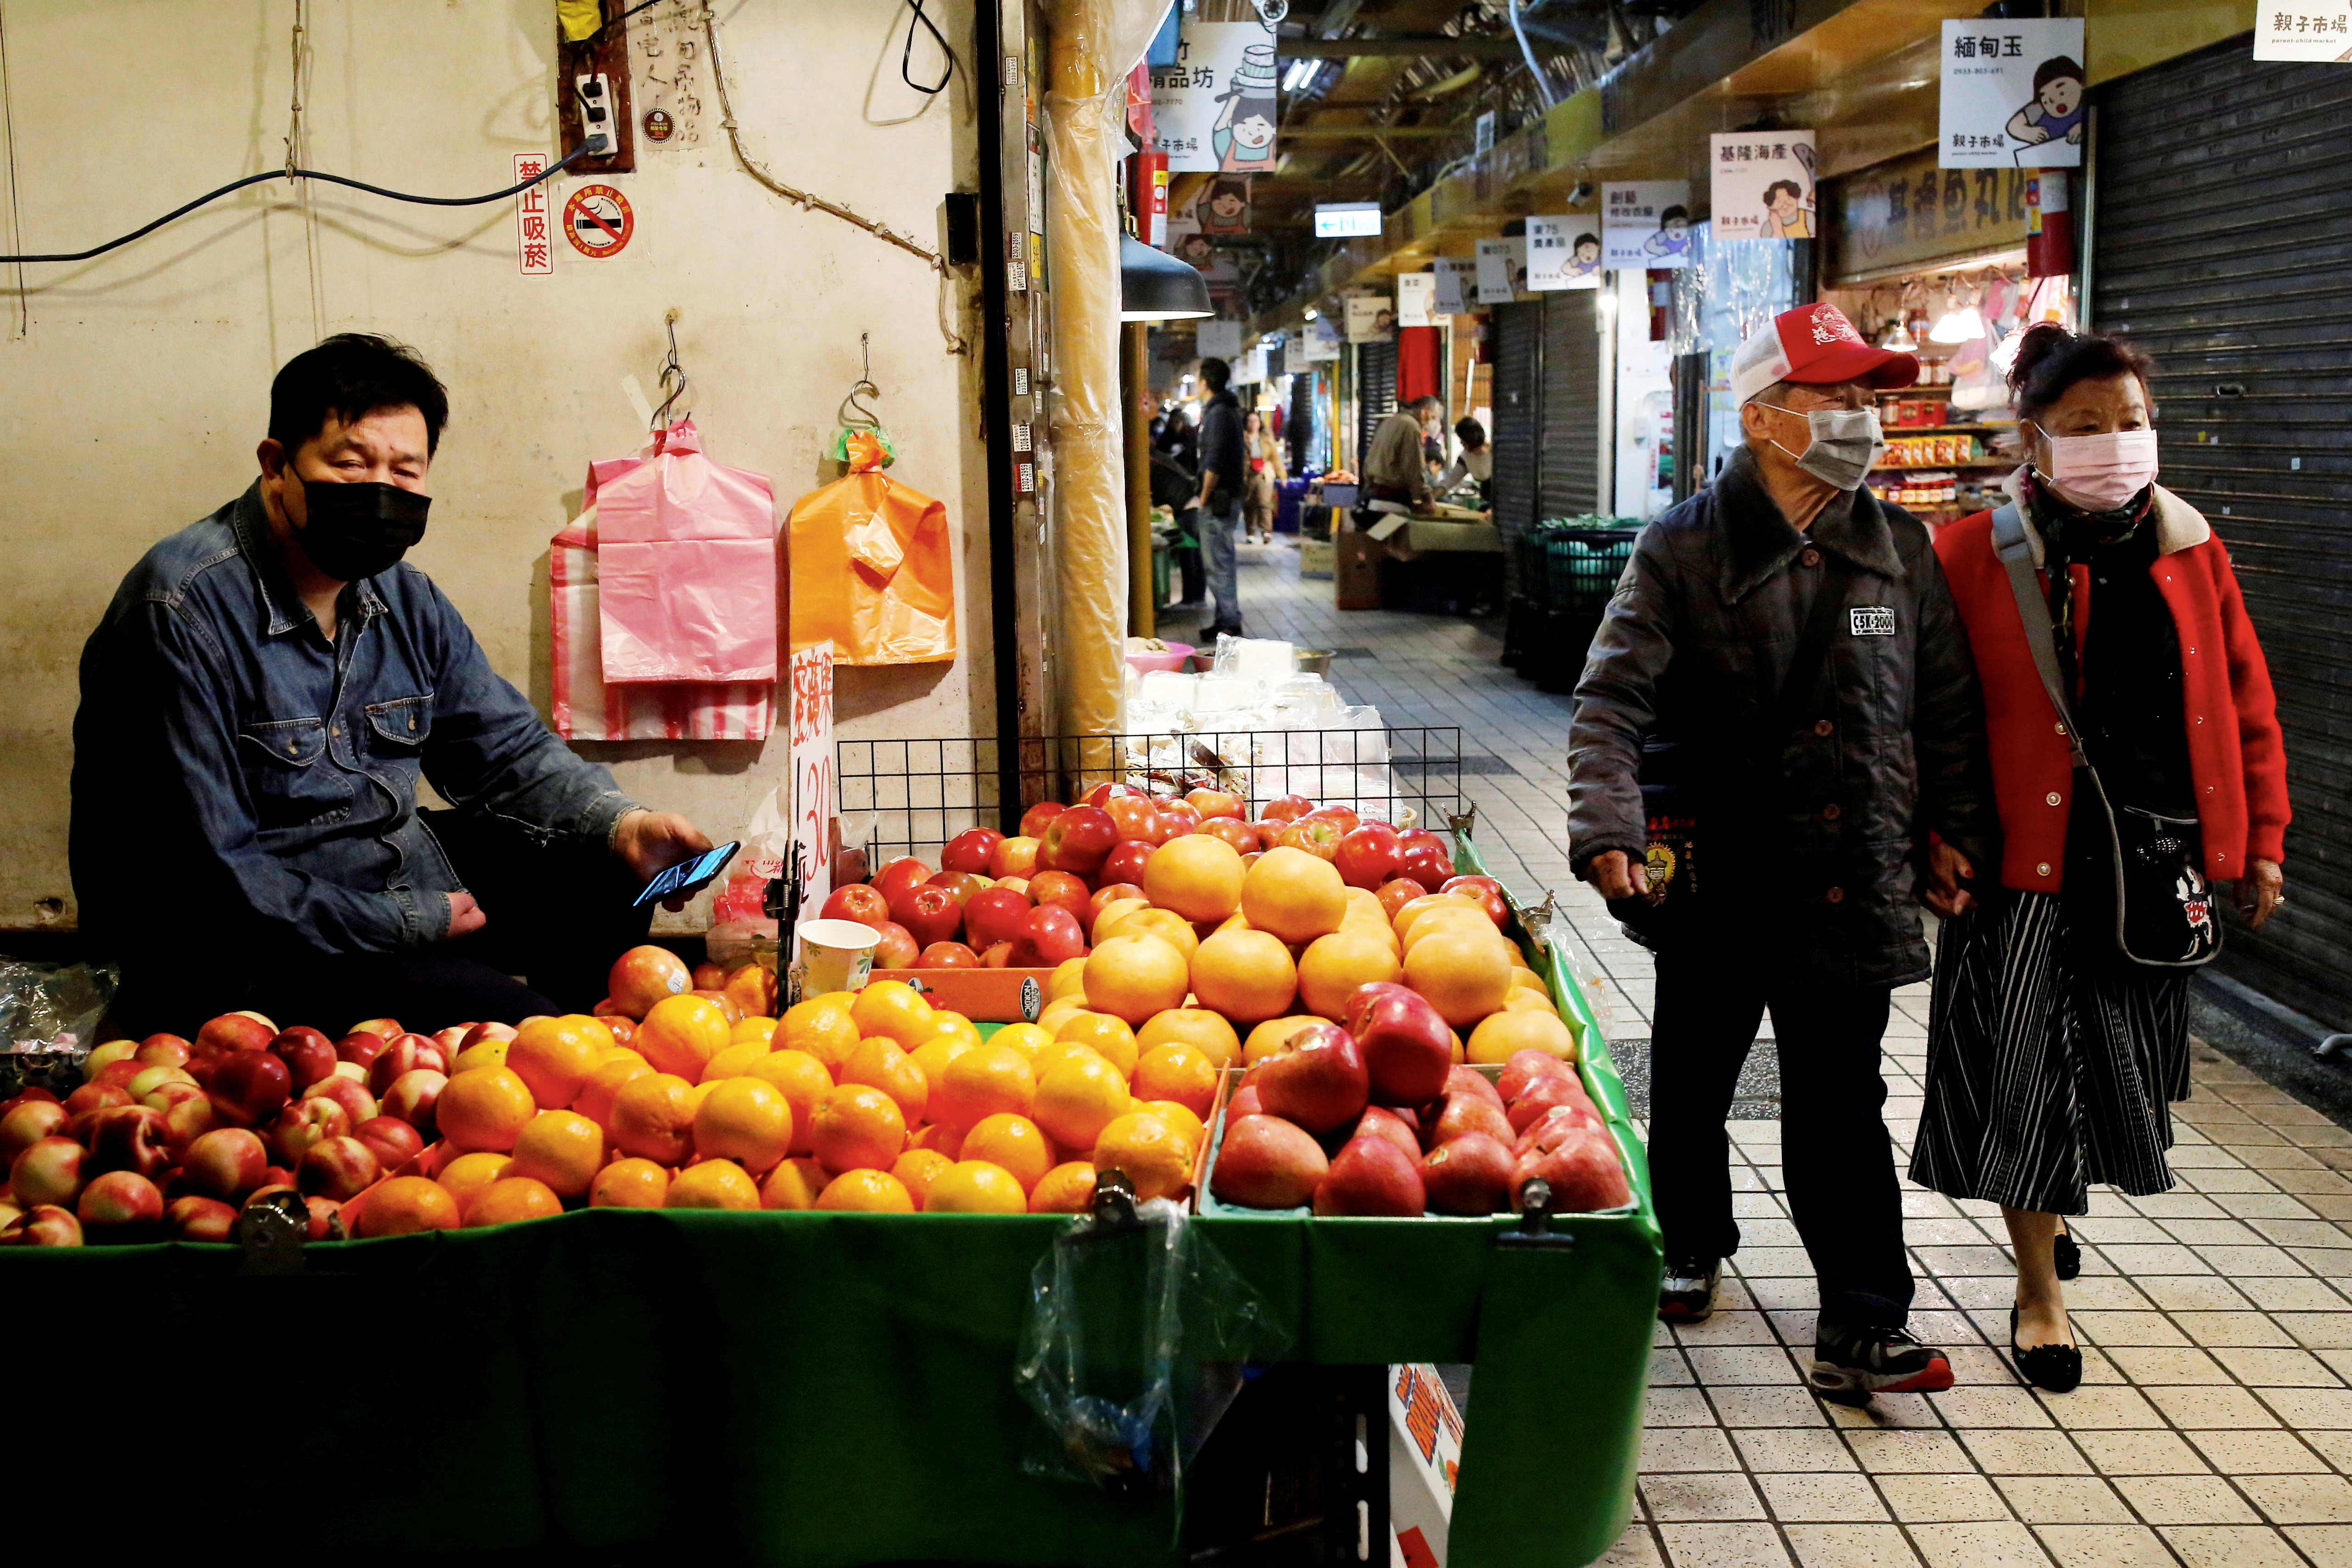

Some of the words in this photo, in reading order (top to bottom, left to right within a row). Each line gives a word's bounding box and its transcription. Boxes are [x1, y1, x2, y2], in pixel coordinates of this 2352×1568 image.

[2274, 12, 2347, 33] 親子市場
[1954, 36, 2023, 58] 緬甸玉
[1162, 138, 1198, 151] 子市場
[1953, 134, 2004, 148] 親子市場
[1721, 143, 1787, 162] 基隆海產
[520, 161, 547, 268] 禁止吸菸
[1021, 465, 1029, 490] 2302-2959
[806, 755, 831, 881] 30
[1406, 1366, 1440, 1467] BRAVE
